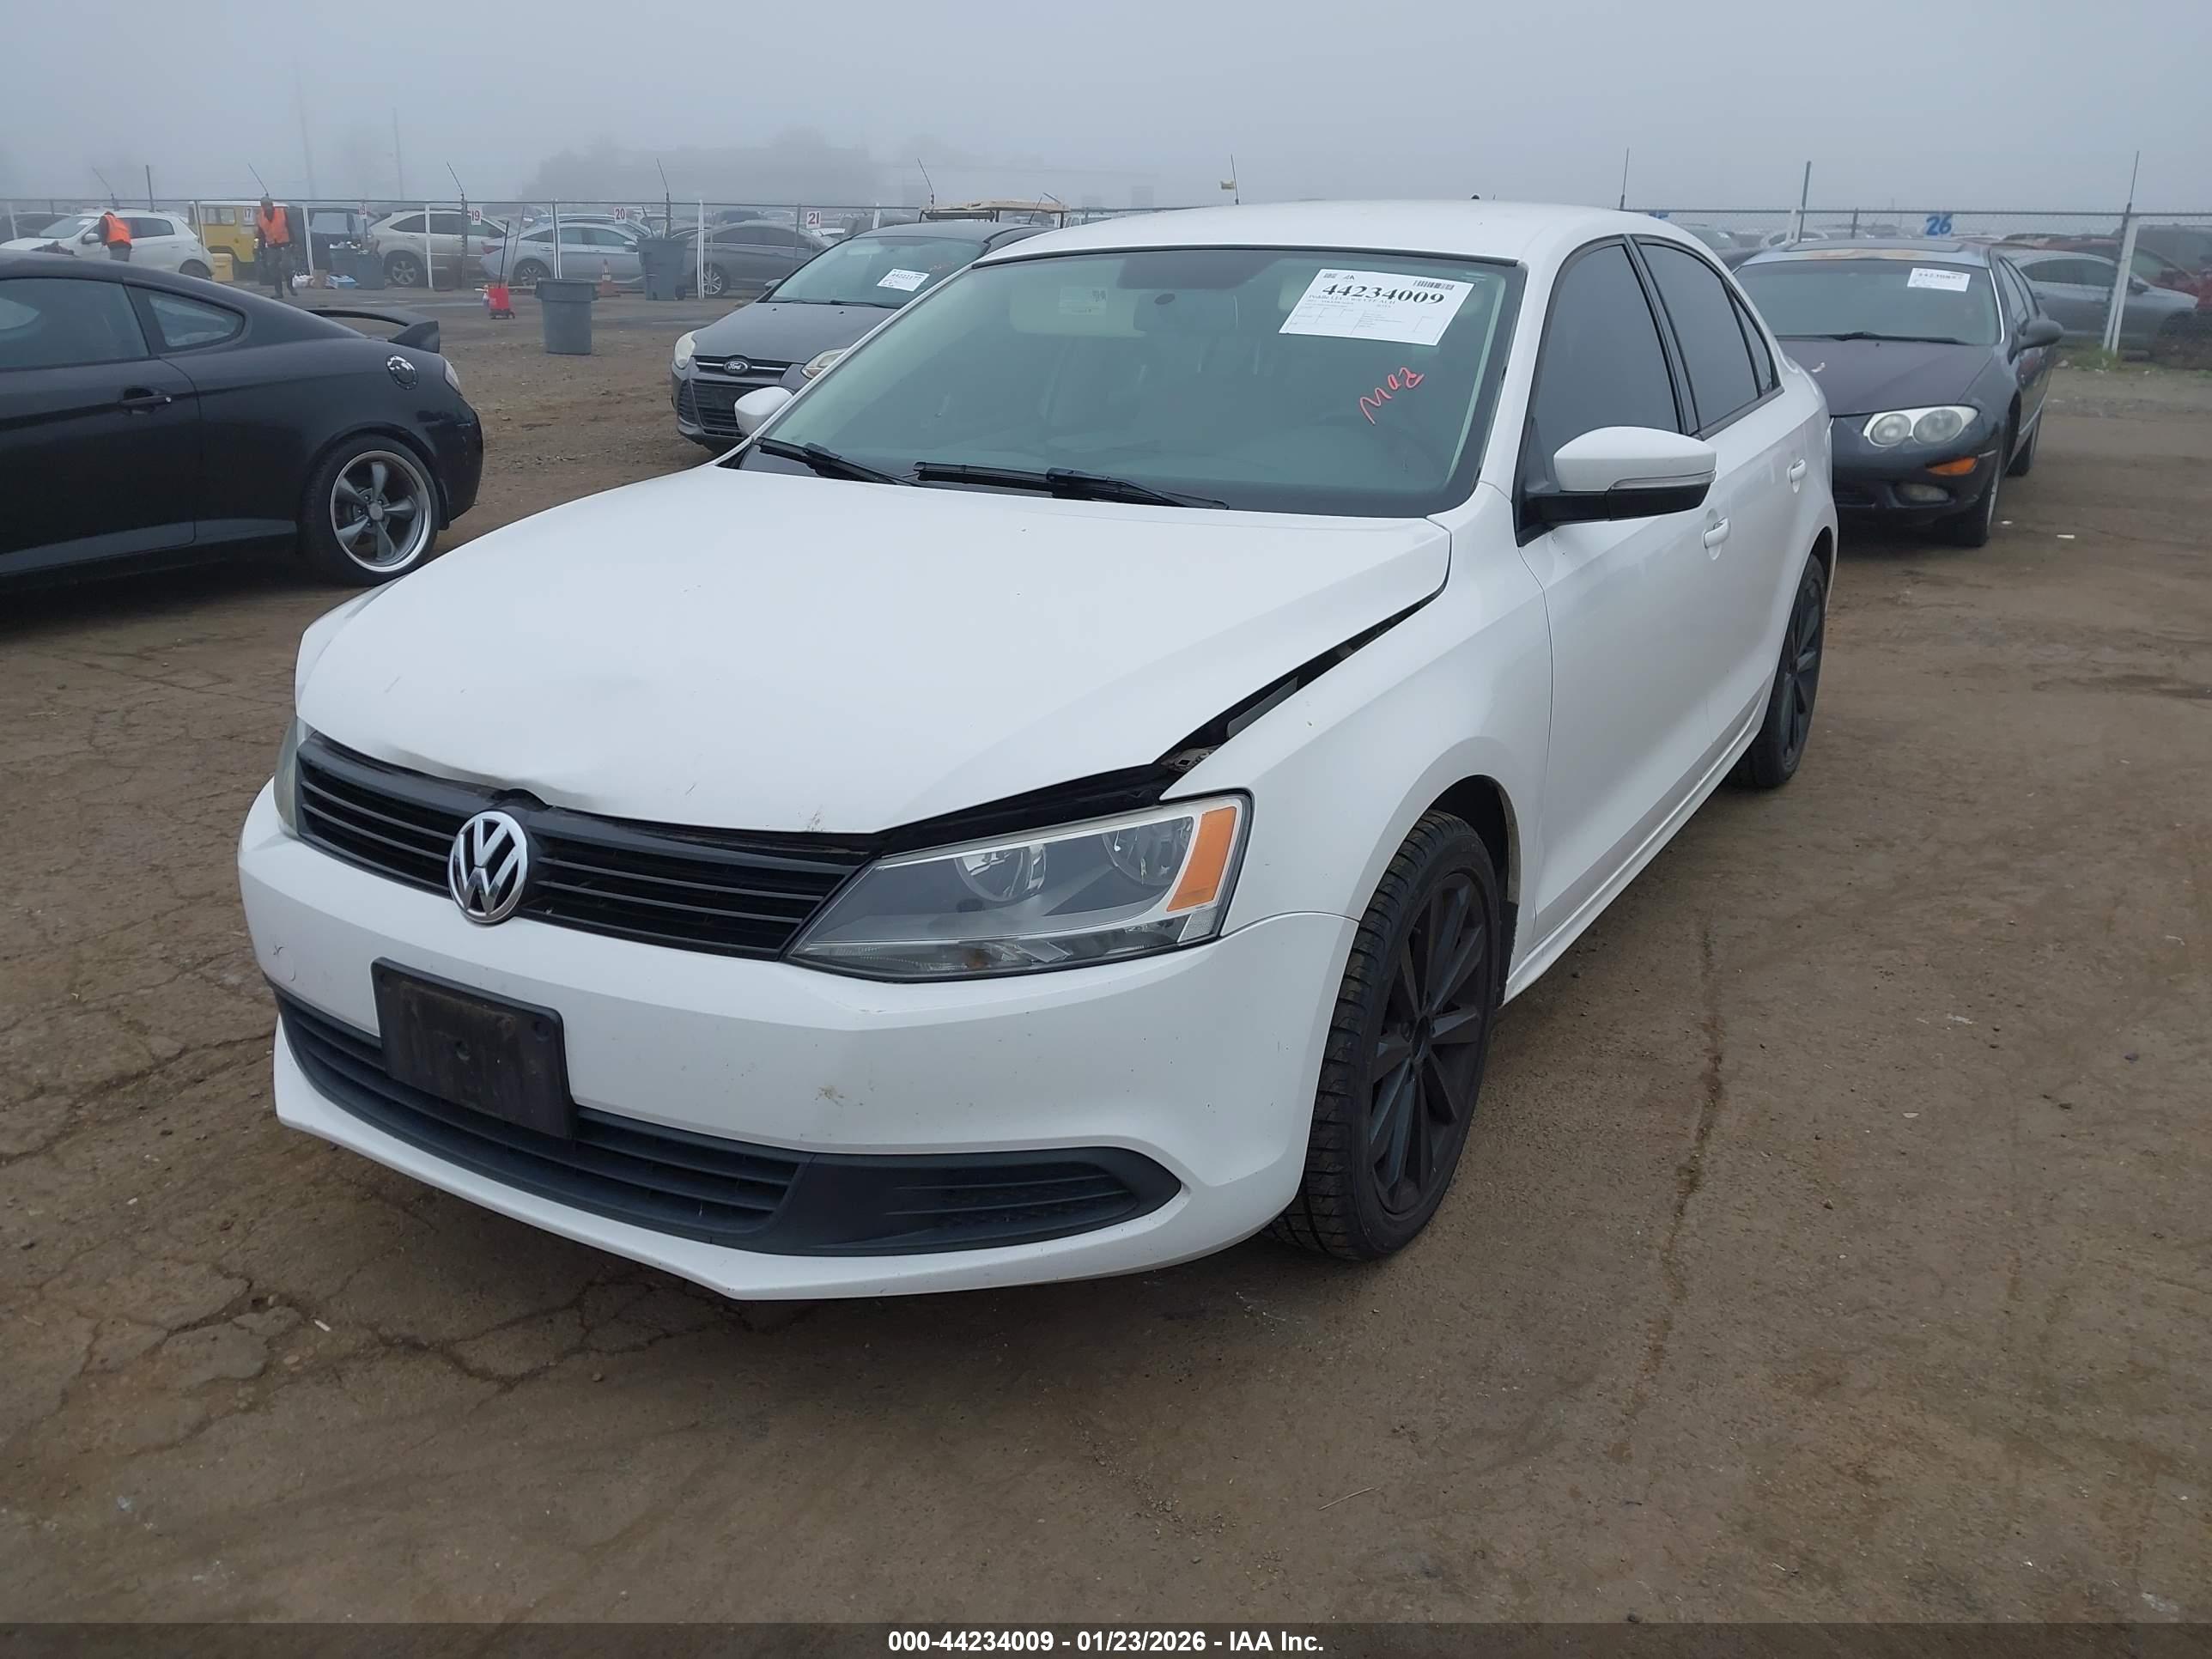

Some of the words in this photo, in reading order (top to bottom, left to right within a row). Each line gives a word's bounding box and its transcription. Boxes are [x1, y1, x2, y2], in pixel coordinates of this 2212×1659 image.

[471, 210, 480, 221] 19
[615, 208, 625, 220] 20
[807, 212, 819, 224] 21
[1926, 215, 1952, 235] 26
[1322, 283, 1444, 305] 44234009
